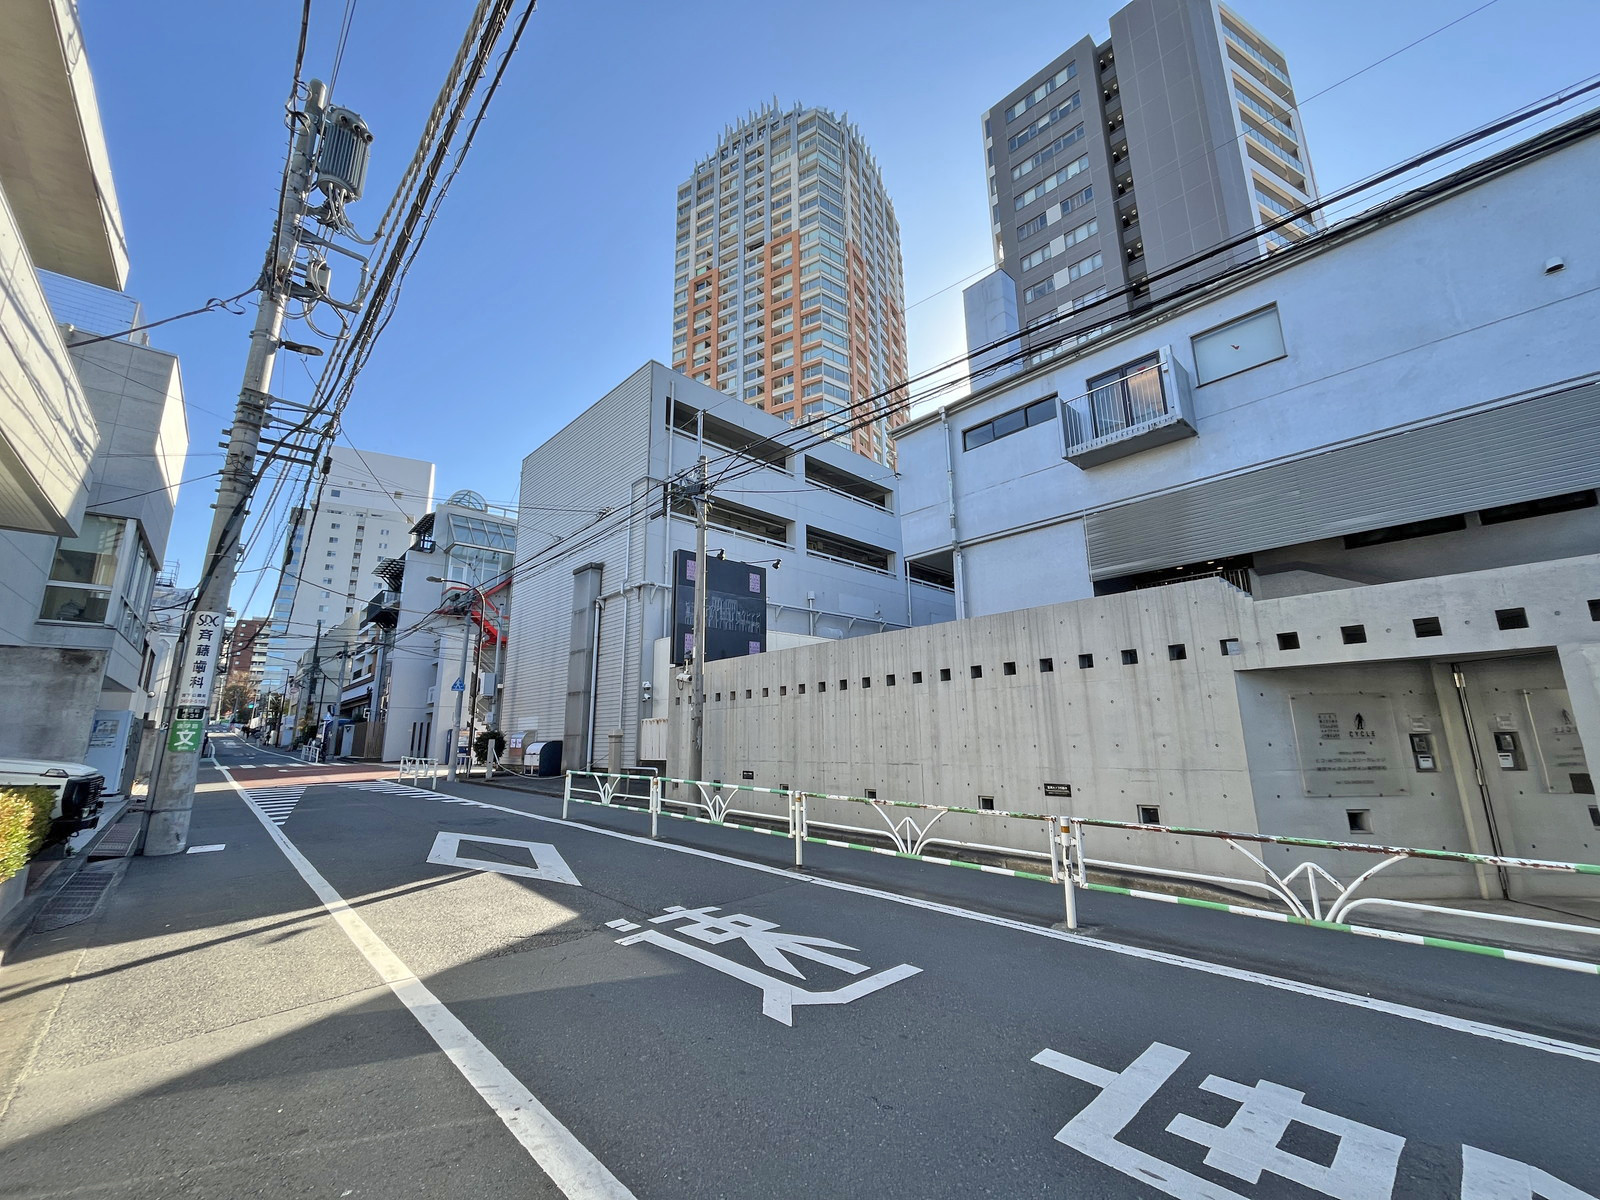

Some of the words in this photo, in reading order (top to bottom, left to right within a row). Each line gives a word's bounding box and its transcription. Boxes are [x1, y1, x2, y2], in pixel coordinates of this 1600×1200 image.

[196, 614, 219, 627] SDC
[189, 629, 214, 689] 斉藤歯科
[173, 730, 196, 746] 文
